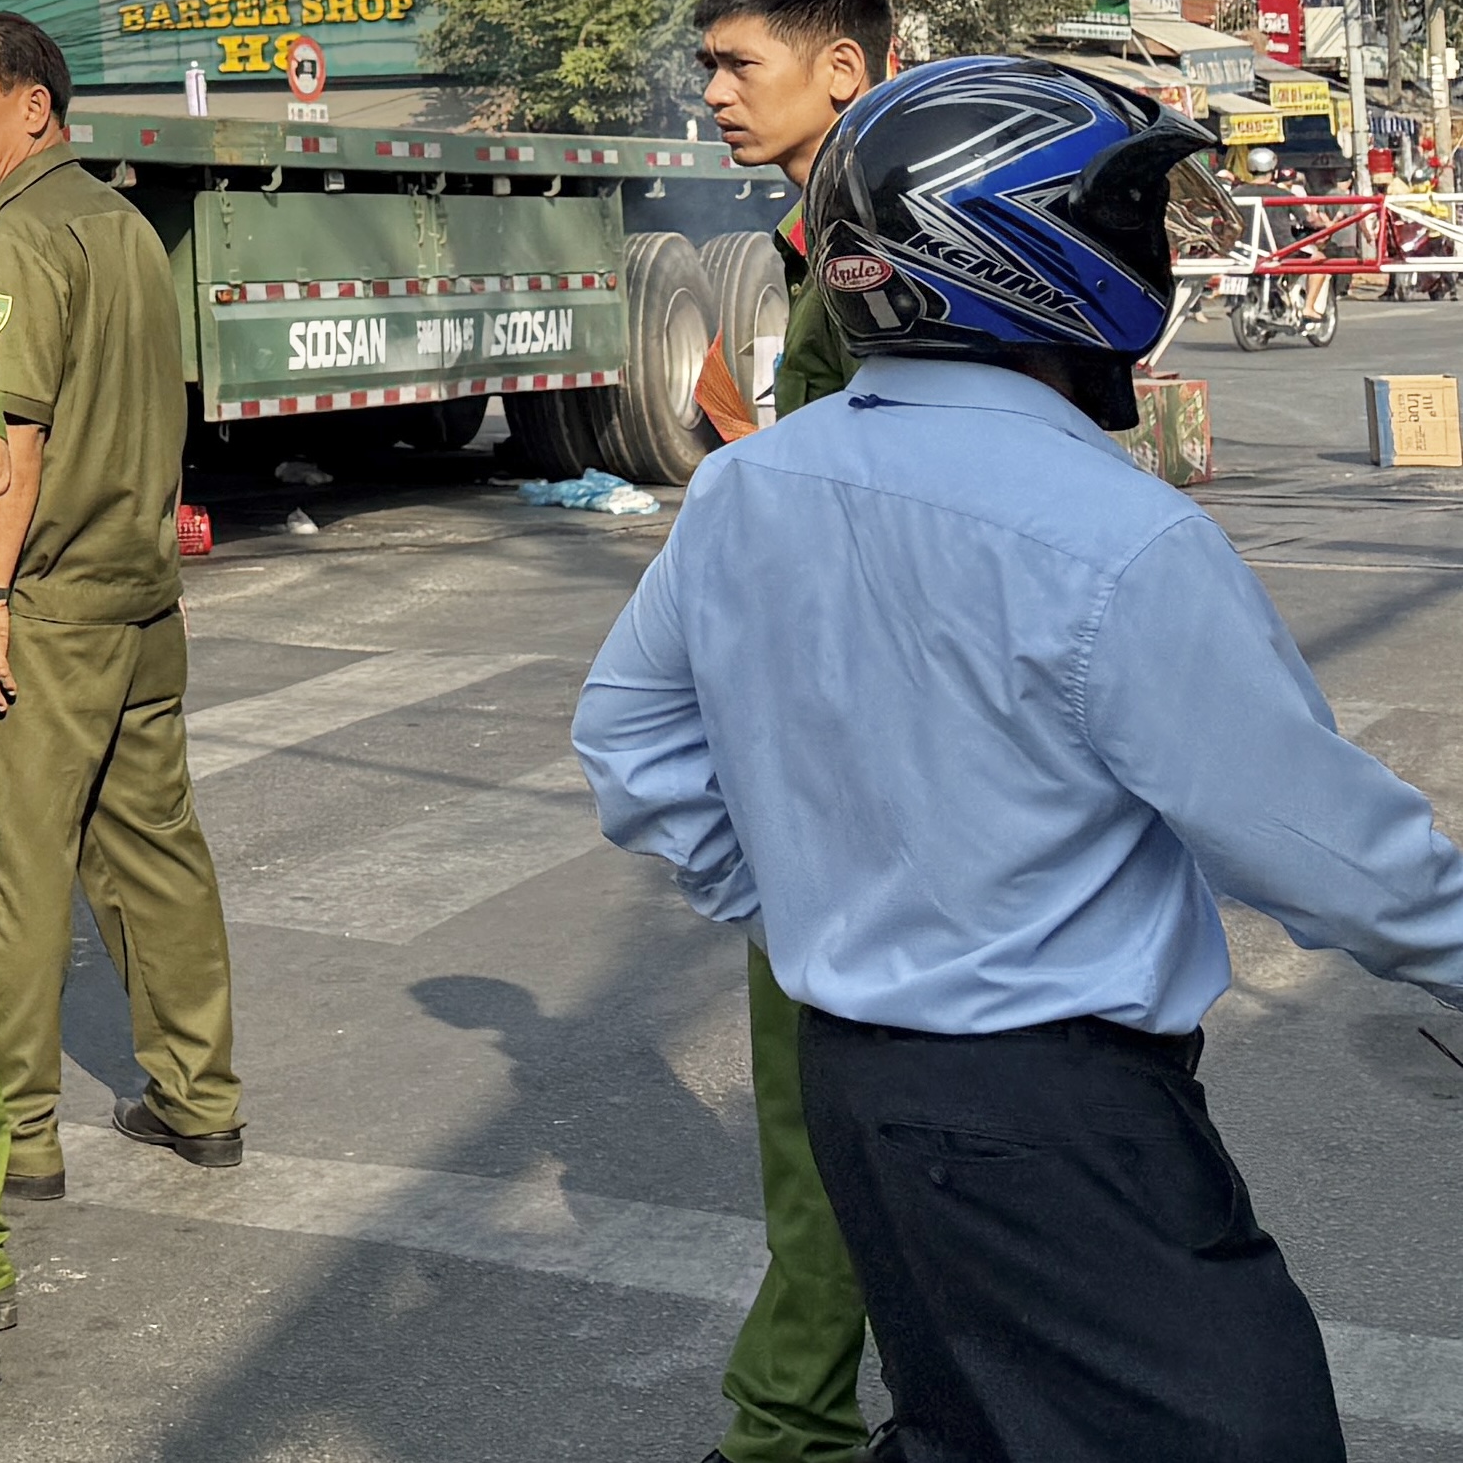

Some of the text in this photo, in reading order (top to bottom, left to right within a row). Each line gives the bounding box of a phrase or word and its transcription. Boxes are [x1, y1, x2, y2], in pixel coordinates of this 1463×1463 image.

[903, 230, 1087, 314] KENNY
[288, 318, 387, 371] SOOSAN
[489, 308, 574, 357] SOOSAN
